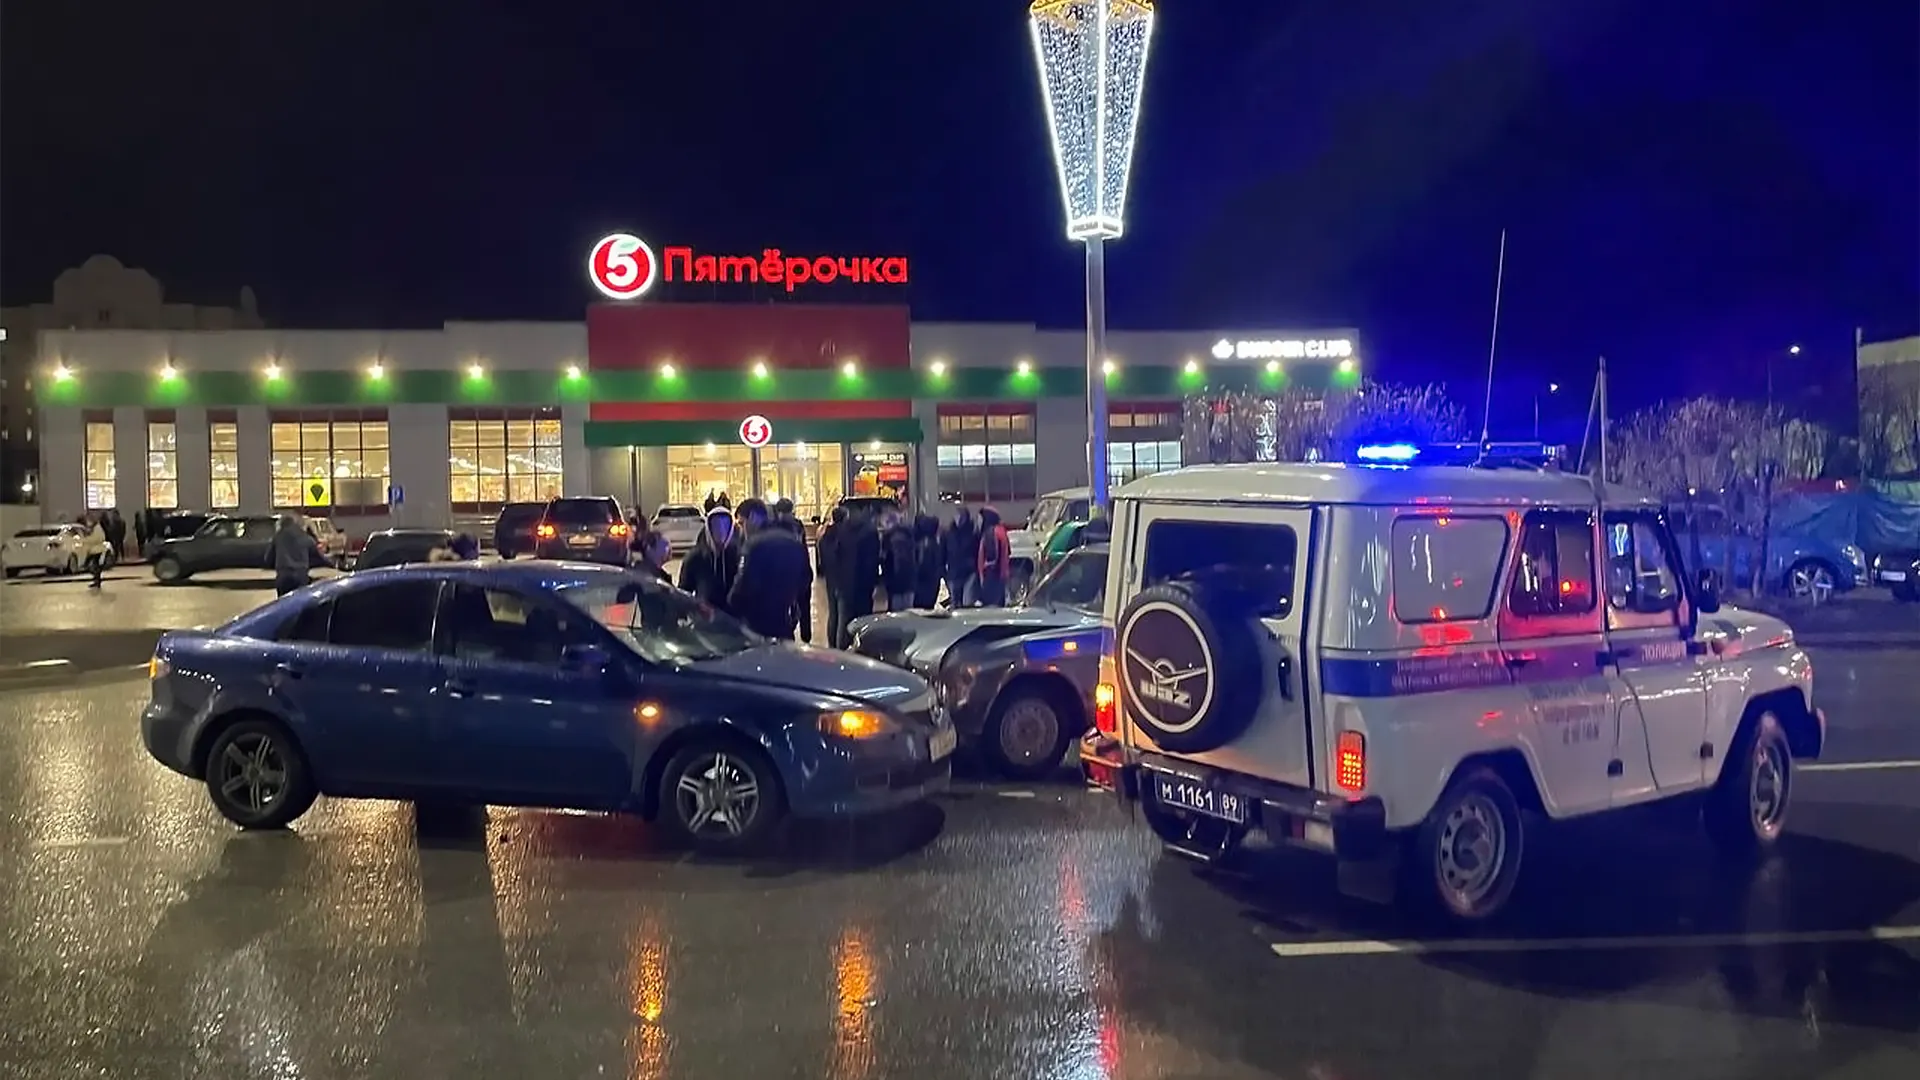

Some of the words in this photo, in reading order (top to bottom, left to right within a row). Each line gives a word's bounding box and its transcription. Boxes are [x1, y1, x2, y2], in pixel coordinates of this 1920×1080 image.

[606, 238, 642, 287] 5
[664, 246, 908, 291] Пятёрочка
[1178, 784, 1213, 811] 1161
[1222, 793, 1237, 810] 89
